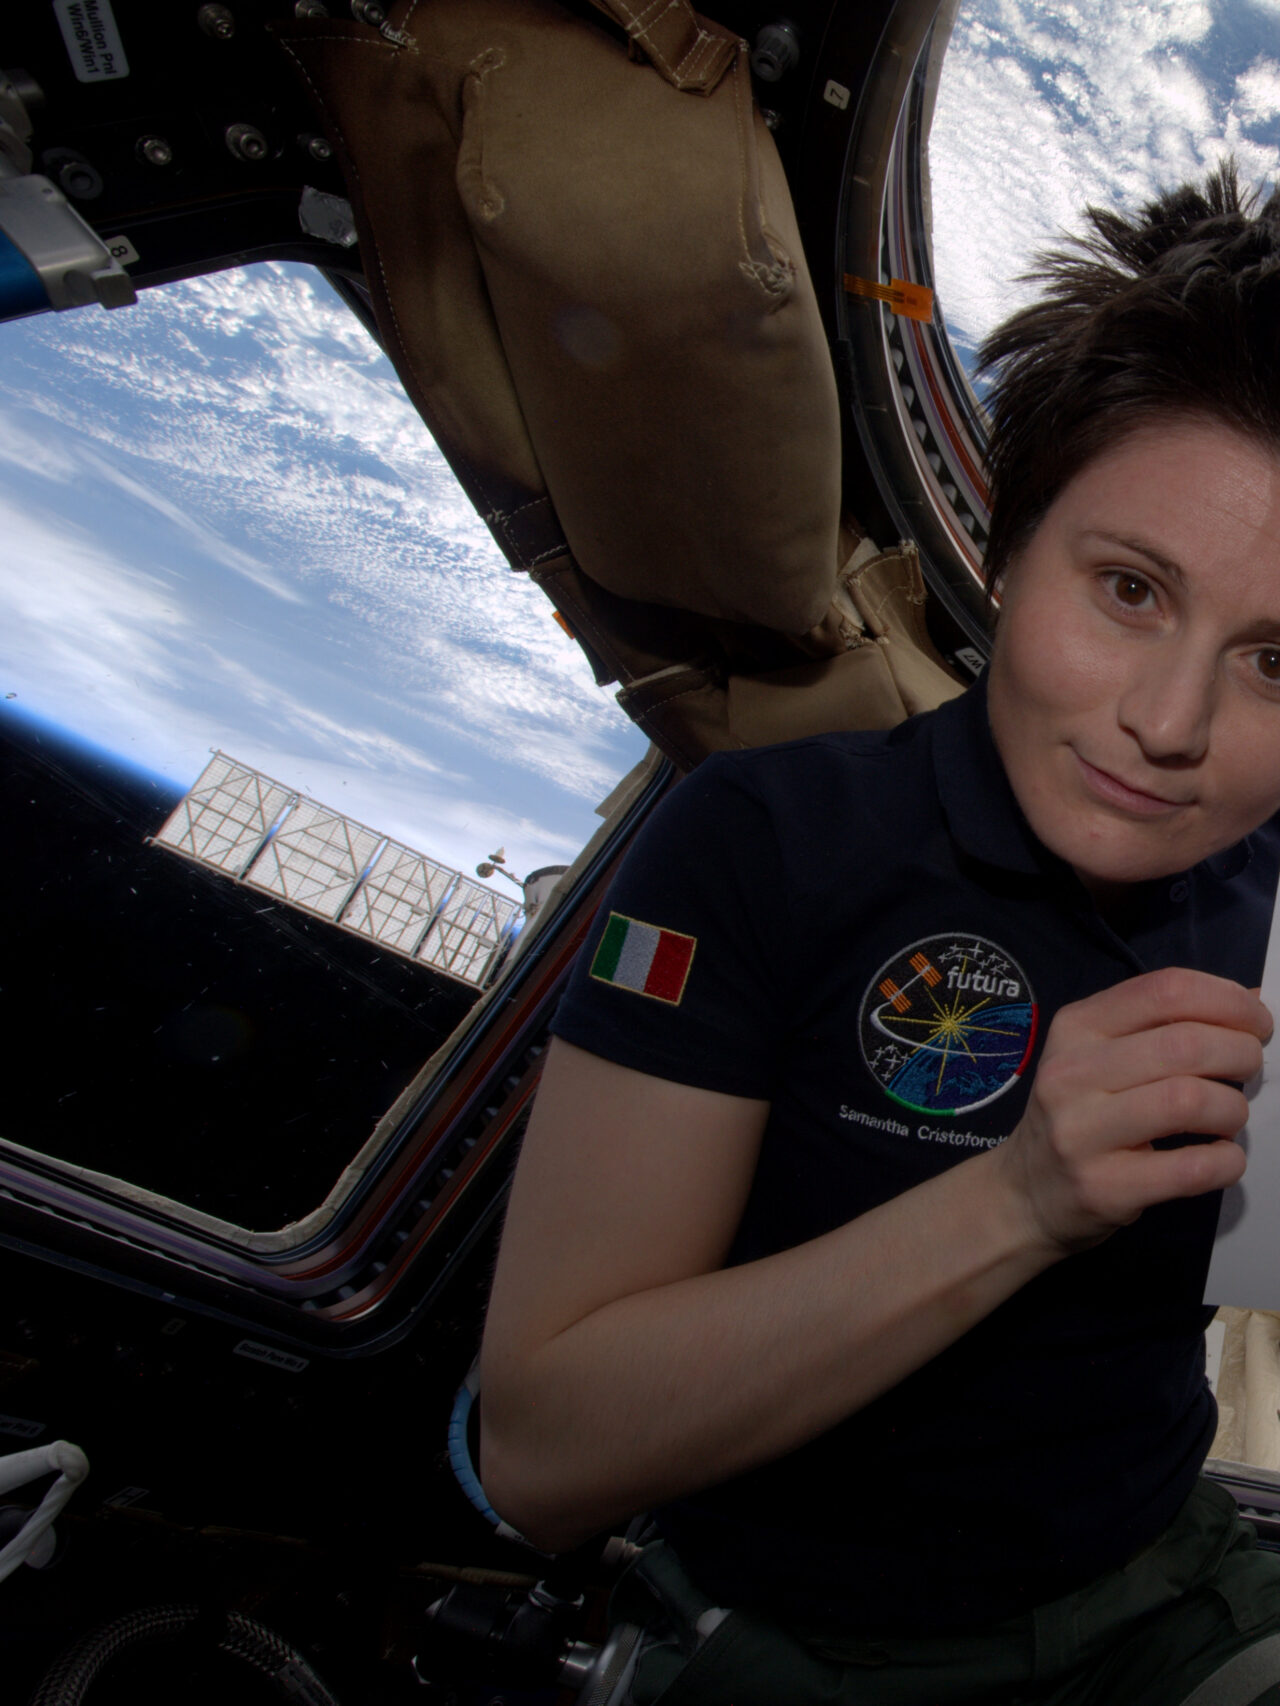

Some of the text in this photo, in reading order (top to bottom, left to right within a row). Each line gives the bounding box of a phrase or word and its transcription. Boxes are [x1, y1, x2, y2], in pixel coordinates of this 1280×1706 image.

[67, 3, 100, 73] Win6/Win1
[83, 0, 117, 74] Mullion Pnl
[830, 88, 843, 101] 7
[111, 245, 128, 257] 8
[947, 965, 1021, 998] futura
[839, 1104, 909, 1137] Samantha
